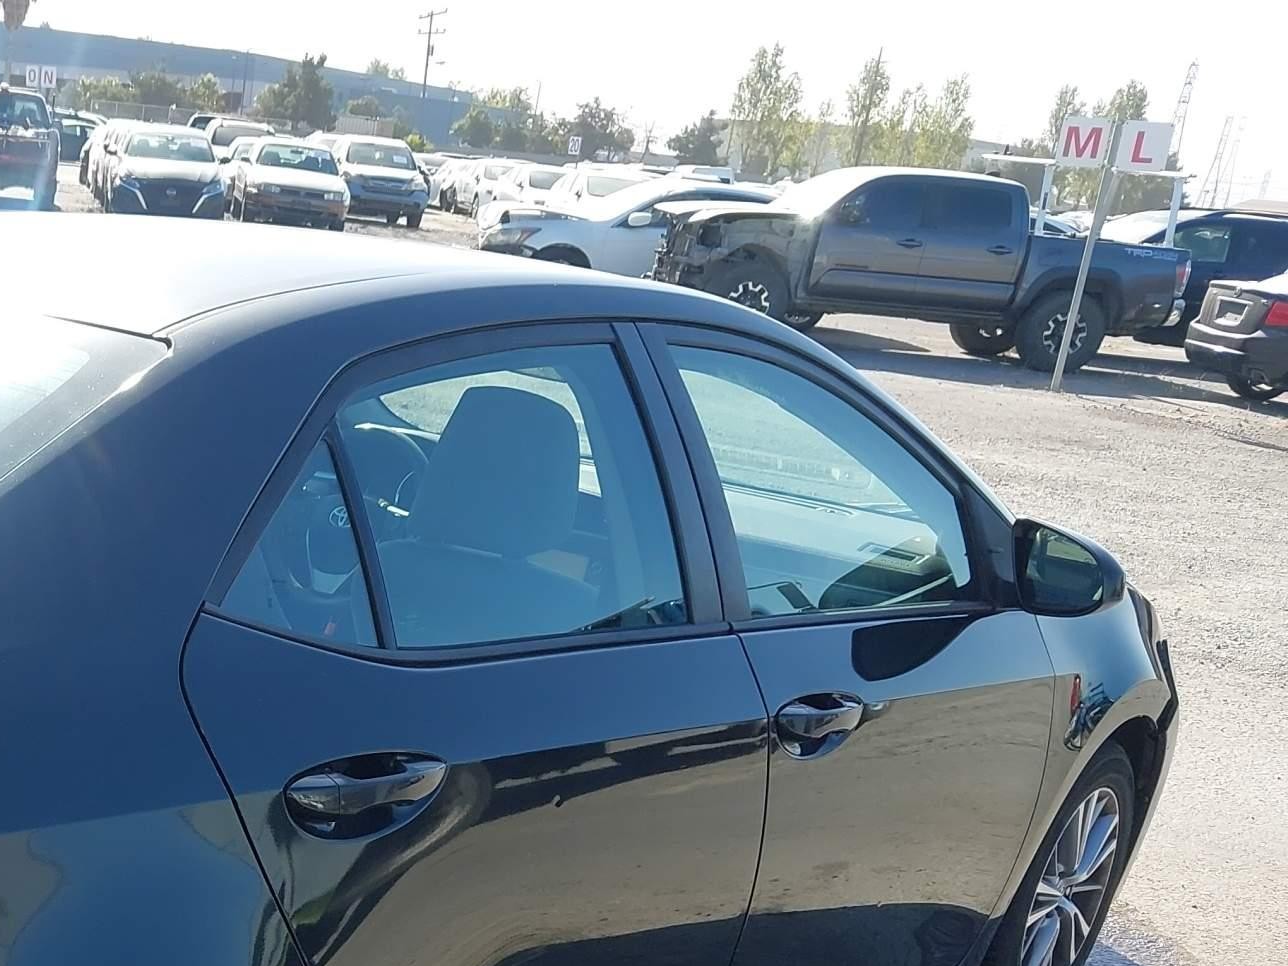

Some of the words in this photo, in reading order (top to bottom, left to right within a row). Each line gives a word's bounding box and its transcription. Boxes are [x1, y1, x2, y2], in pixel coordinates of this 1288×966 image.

[43, 70, 54, 85] N
[569, 137, 581, 153] 20
[1062, 126, 1103, 159] M
[1131, 130, 1153, 164] L
